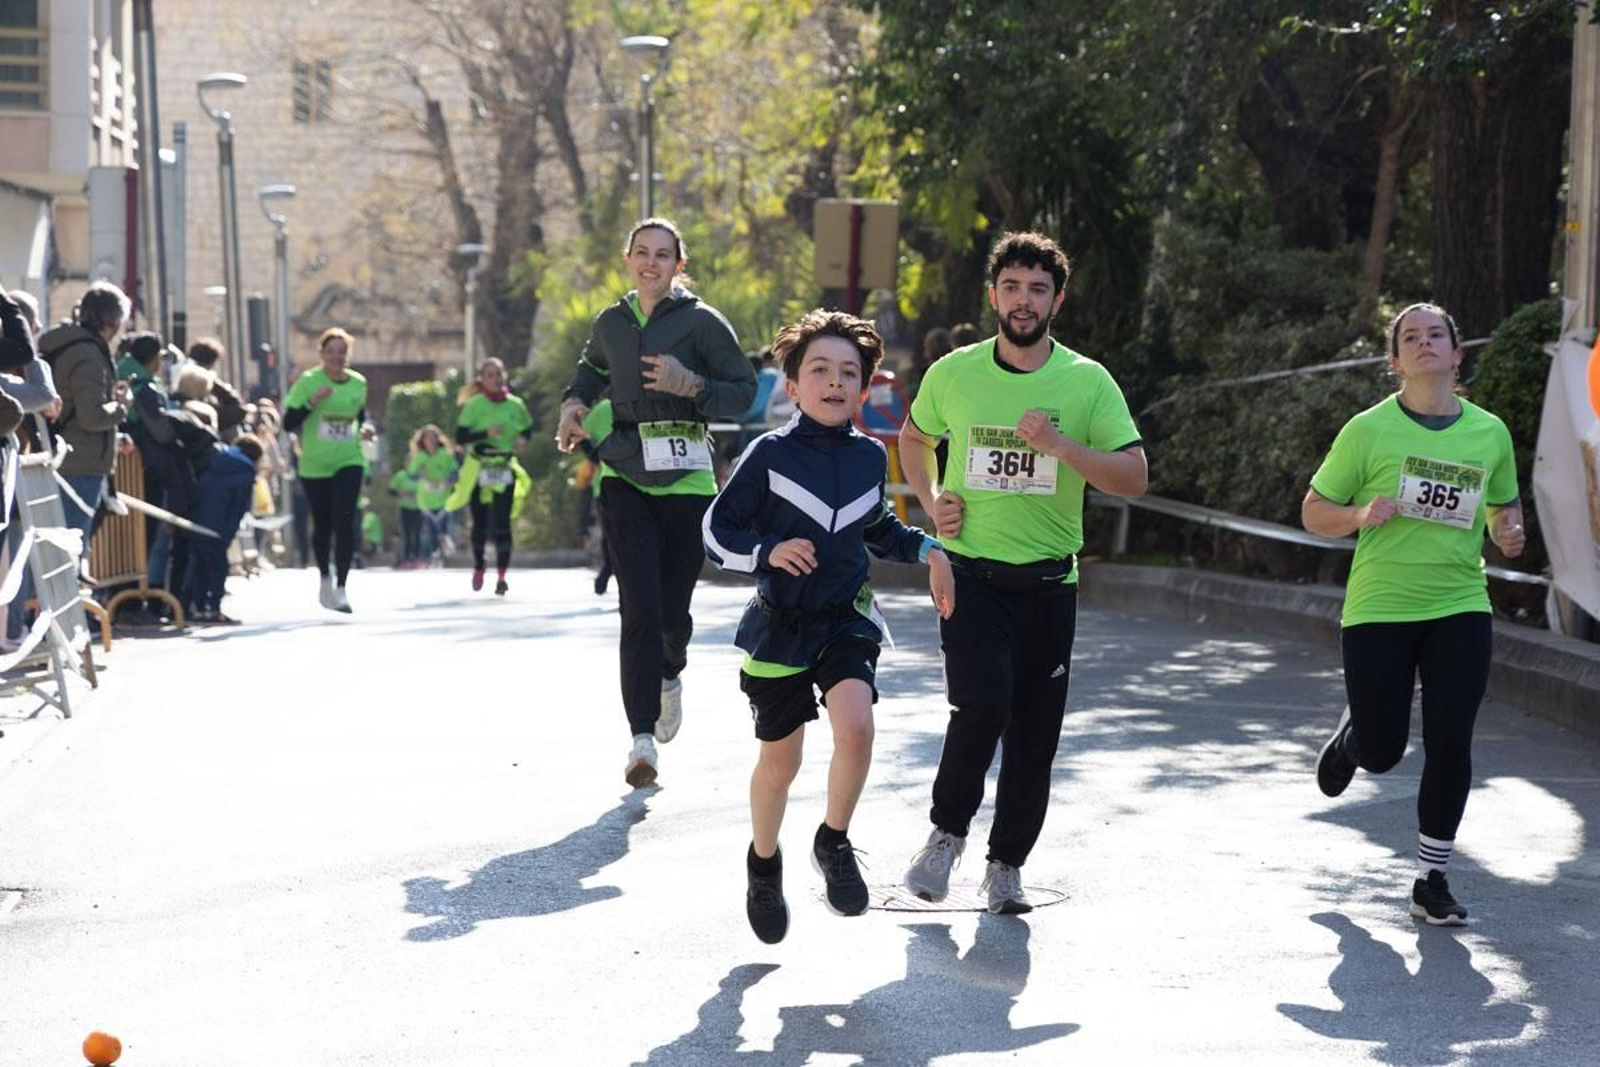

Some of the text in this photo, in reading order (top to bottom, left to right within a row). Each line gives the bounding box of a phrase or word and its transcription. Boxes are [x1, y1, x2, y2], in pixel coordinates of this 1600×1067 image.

[668, 438, 687, 457] 13
[988, 450, 1035, 478] 364
[1416, 481, 1462, 511] 365
